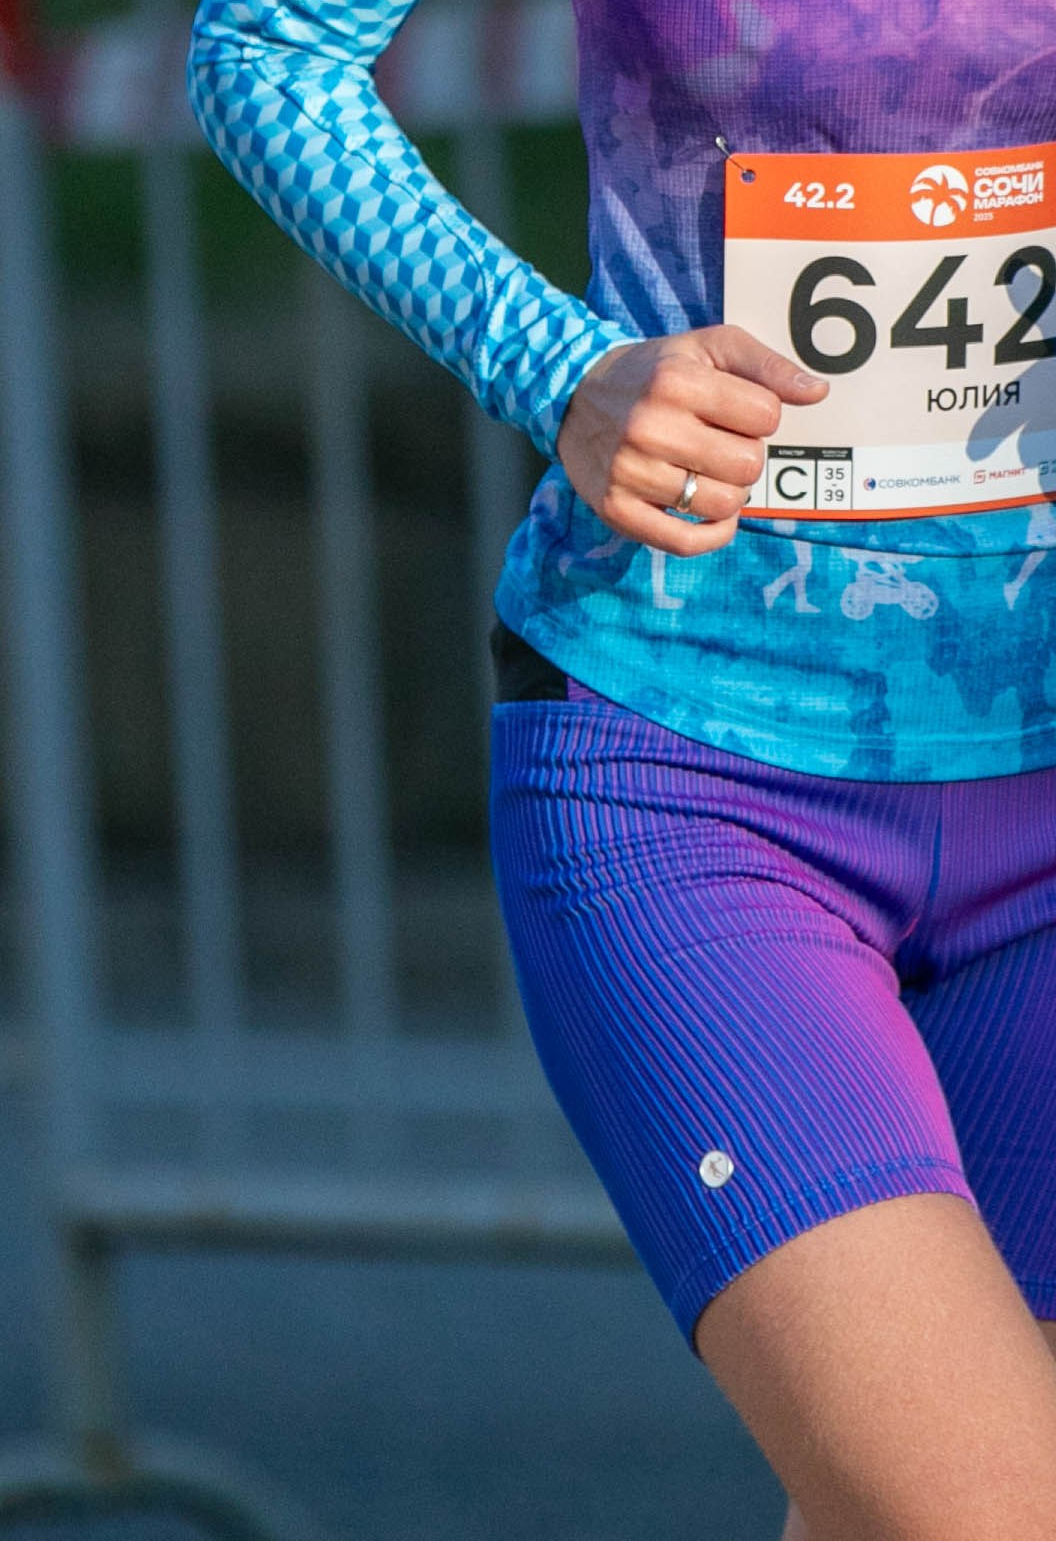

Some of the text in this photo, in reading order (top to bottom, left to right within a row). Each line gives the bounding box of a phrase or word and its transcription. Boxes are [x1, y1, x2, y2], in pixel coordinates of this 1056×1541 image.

[974, 170, 1045, 199] СОЧИ
[783, 181, 855, 210] 42.2
[973, 191, 1045, 210] МАРАФОН
[926, 380, 1021, 413] ЮЛИЯ
[824, 467, 845, 481] 35
[878, 474, 961, 490] СОВКОМБАНК
[988, 467, 1027, 480] МАГНИТ
[824, 489, 845, 502] 39
